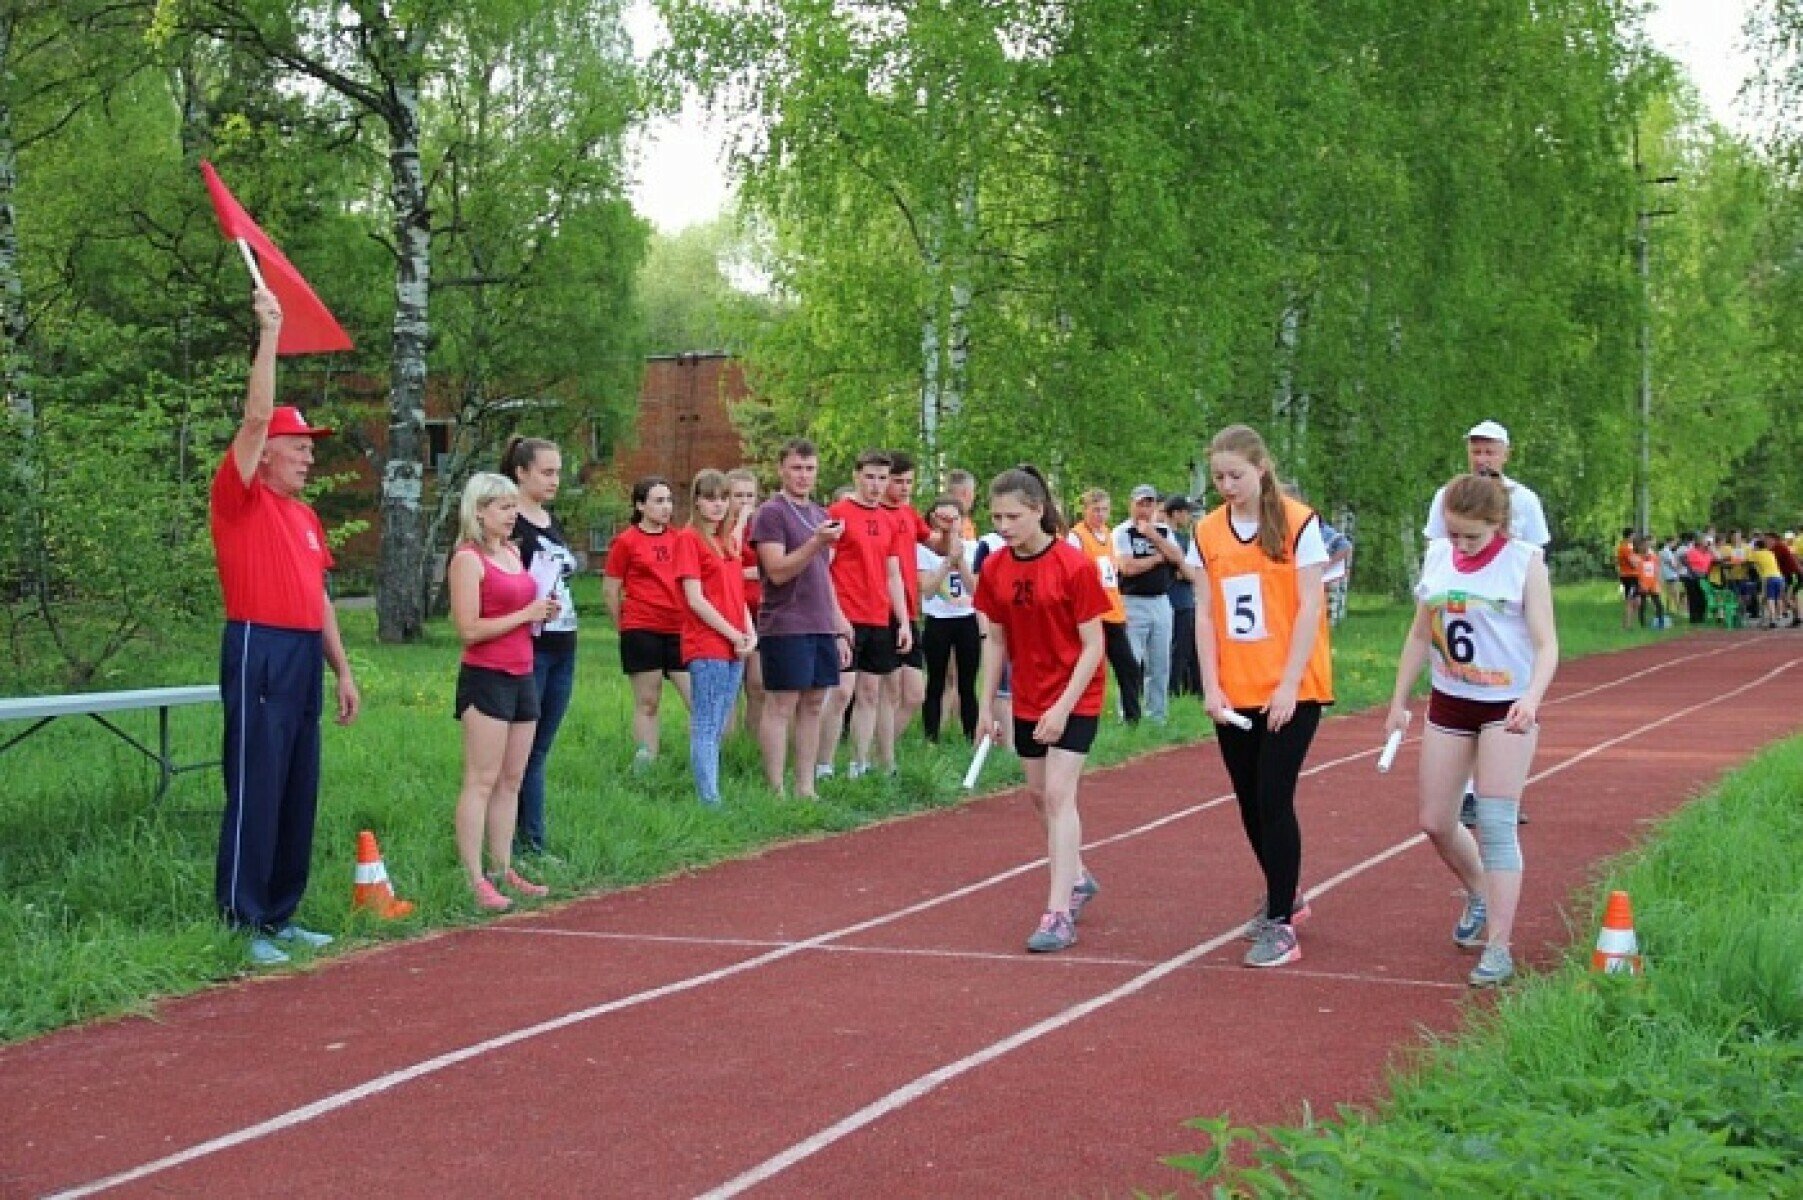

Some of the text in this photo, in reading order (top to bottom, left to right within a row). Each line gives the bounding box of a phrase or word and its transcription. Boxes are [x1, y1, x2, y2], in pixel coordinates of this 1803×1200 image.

[949, 573, 962, 597] 5
[1235, 594, 1255, 635] 5
[1446, 619, 1474, 663] 6
